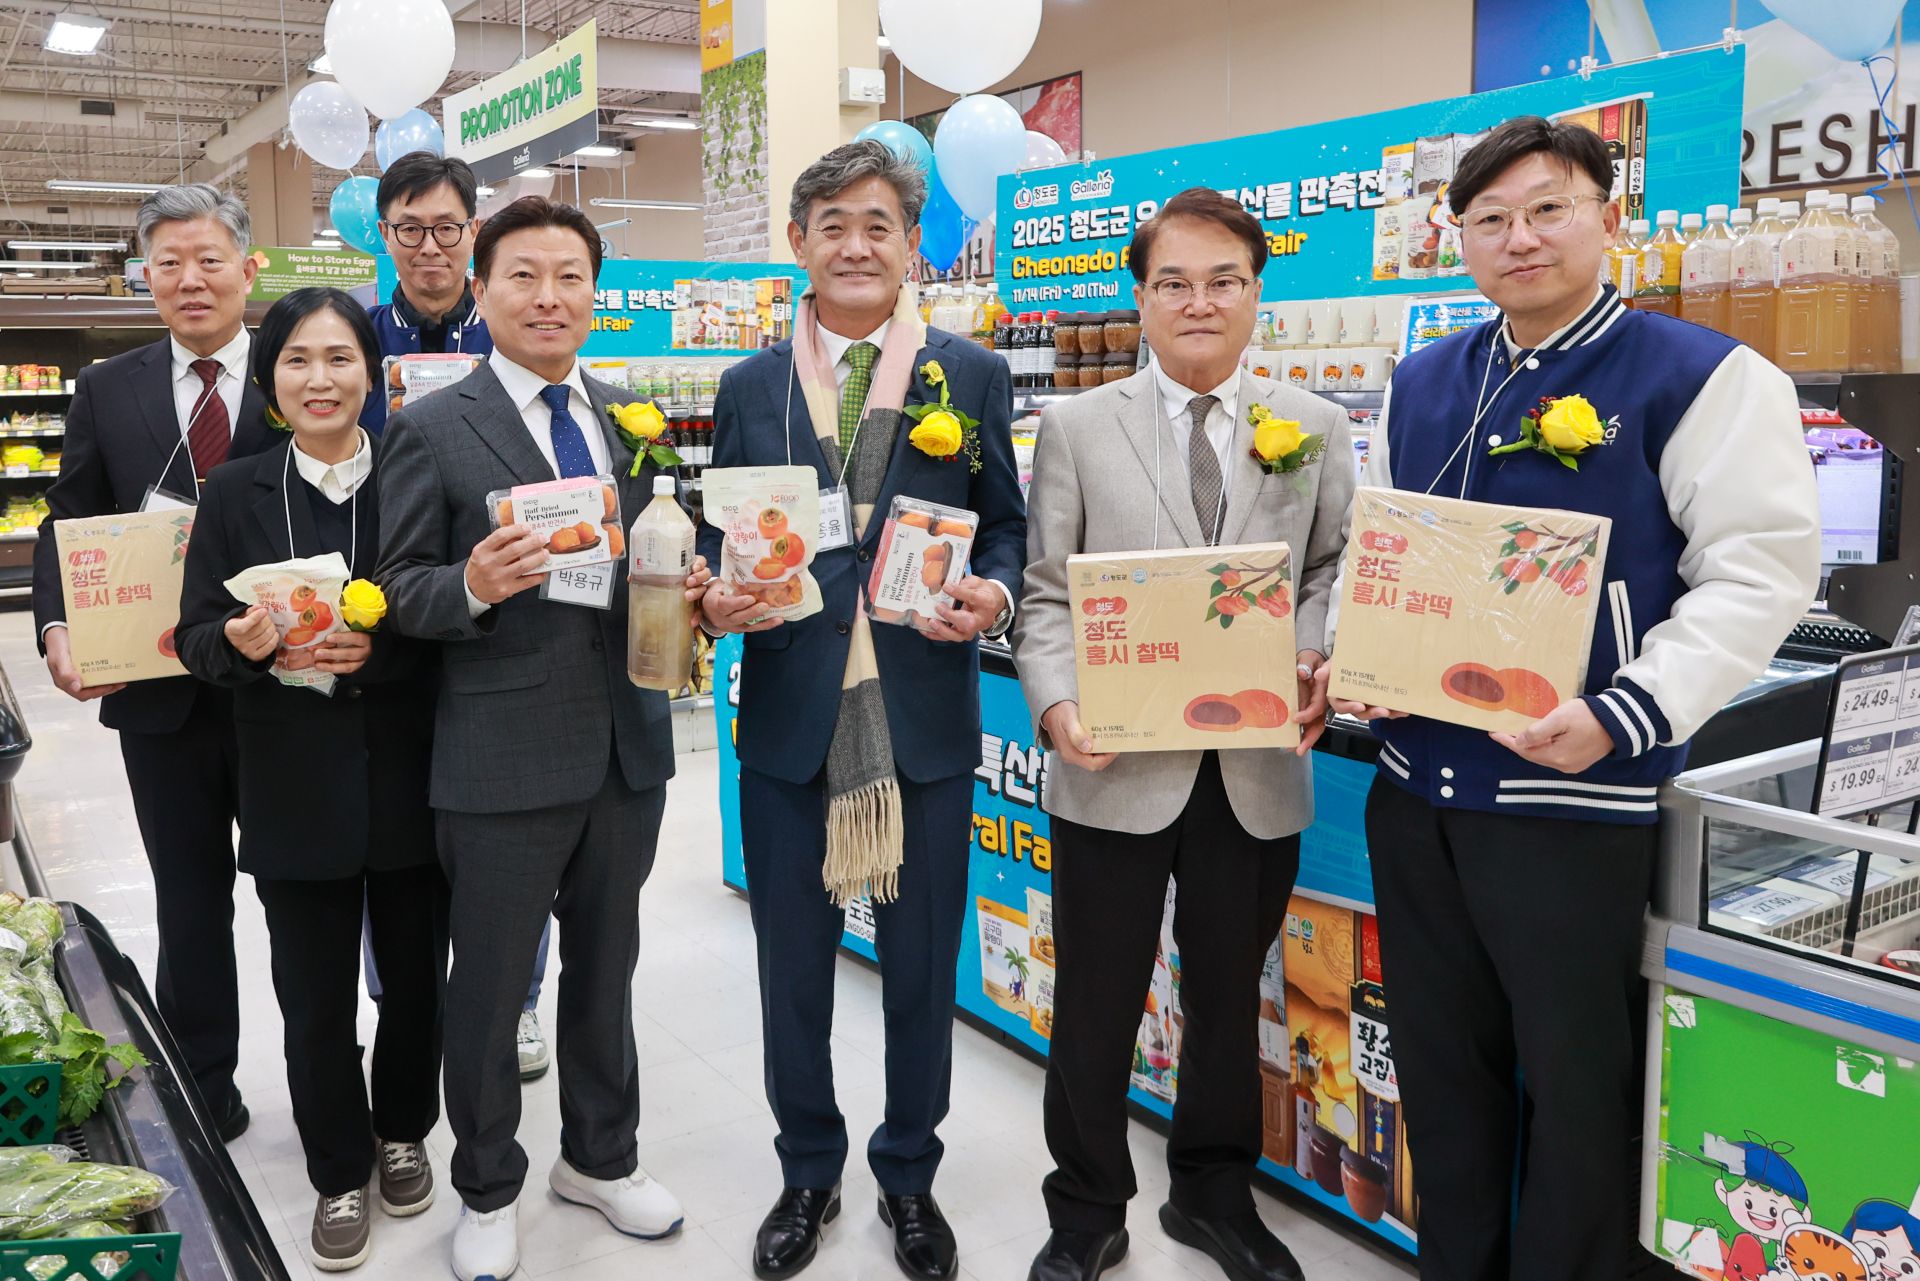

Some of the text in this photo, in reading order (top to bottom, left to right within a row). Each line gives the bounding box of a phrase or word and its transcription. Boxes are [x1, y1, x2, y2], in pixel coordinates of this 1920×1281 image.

[460, 53, 582, 146] PROMOTION ZONE
[1034, 186, 1057, 199] 청도군
[1072, 181, 1111, 194] Galleria
[1013, 214, 1065, 248] 2025
[1070, 205, 1130, 240] 청도군
[1300, 168, 1387, 214] 판촉전
[287, 254, 376, 267] How to Store Eggs
[1013, 248, 1116, 278] Cheongdo
[628, 289, 678, 310] 판촉전
[1013, 287, 1038, 303] 11/14
[1040, 285, 1061, 302] (Fri)
[1072, 283, 1086, 299] 20
[1087, 281, 1118, 299] (Thu)
[602, 316, 634, 331] Fair
[524, 504, 560, 515] Half Dried
[525, 508, 579, 522] Persimmon
[548, 519, 567, 528] 반건시
[70, 569, 108, 588] 청도
[895, 552, 915, 602] Persimmon
[1357, 555, 1402, 582] 청도
[559, 570, 603, 592] 박용규
[889, 567, 903, 600] Half Dried
[73, 584, 152, 609] 홍시 찰떡
[1096, 602, 1114, 612] 청도
[1352, 581, 1453, 619] 홍시 찰떡
[1084, 620, 1128, 642] 청도
[1086, 642, 1180, 666] 홍시 찰떡
[1843, 700, 1850, 713] $
[1852, 689, 1889, 712] 24.49
[1910, 688, 1916, 700] $
[1830, 780, 1837, 793] $
[1841, 768, 1876, 791] 19.99
[1896, 765, 1902, 777] $
[1357, 1021, 1393, 1058] 황소
[1359, 1053, 1390, 1082] 고집
